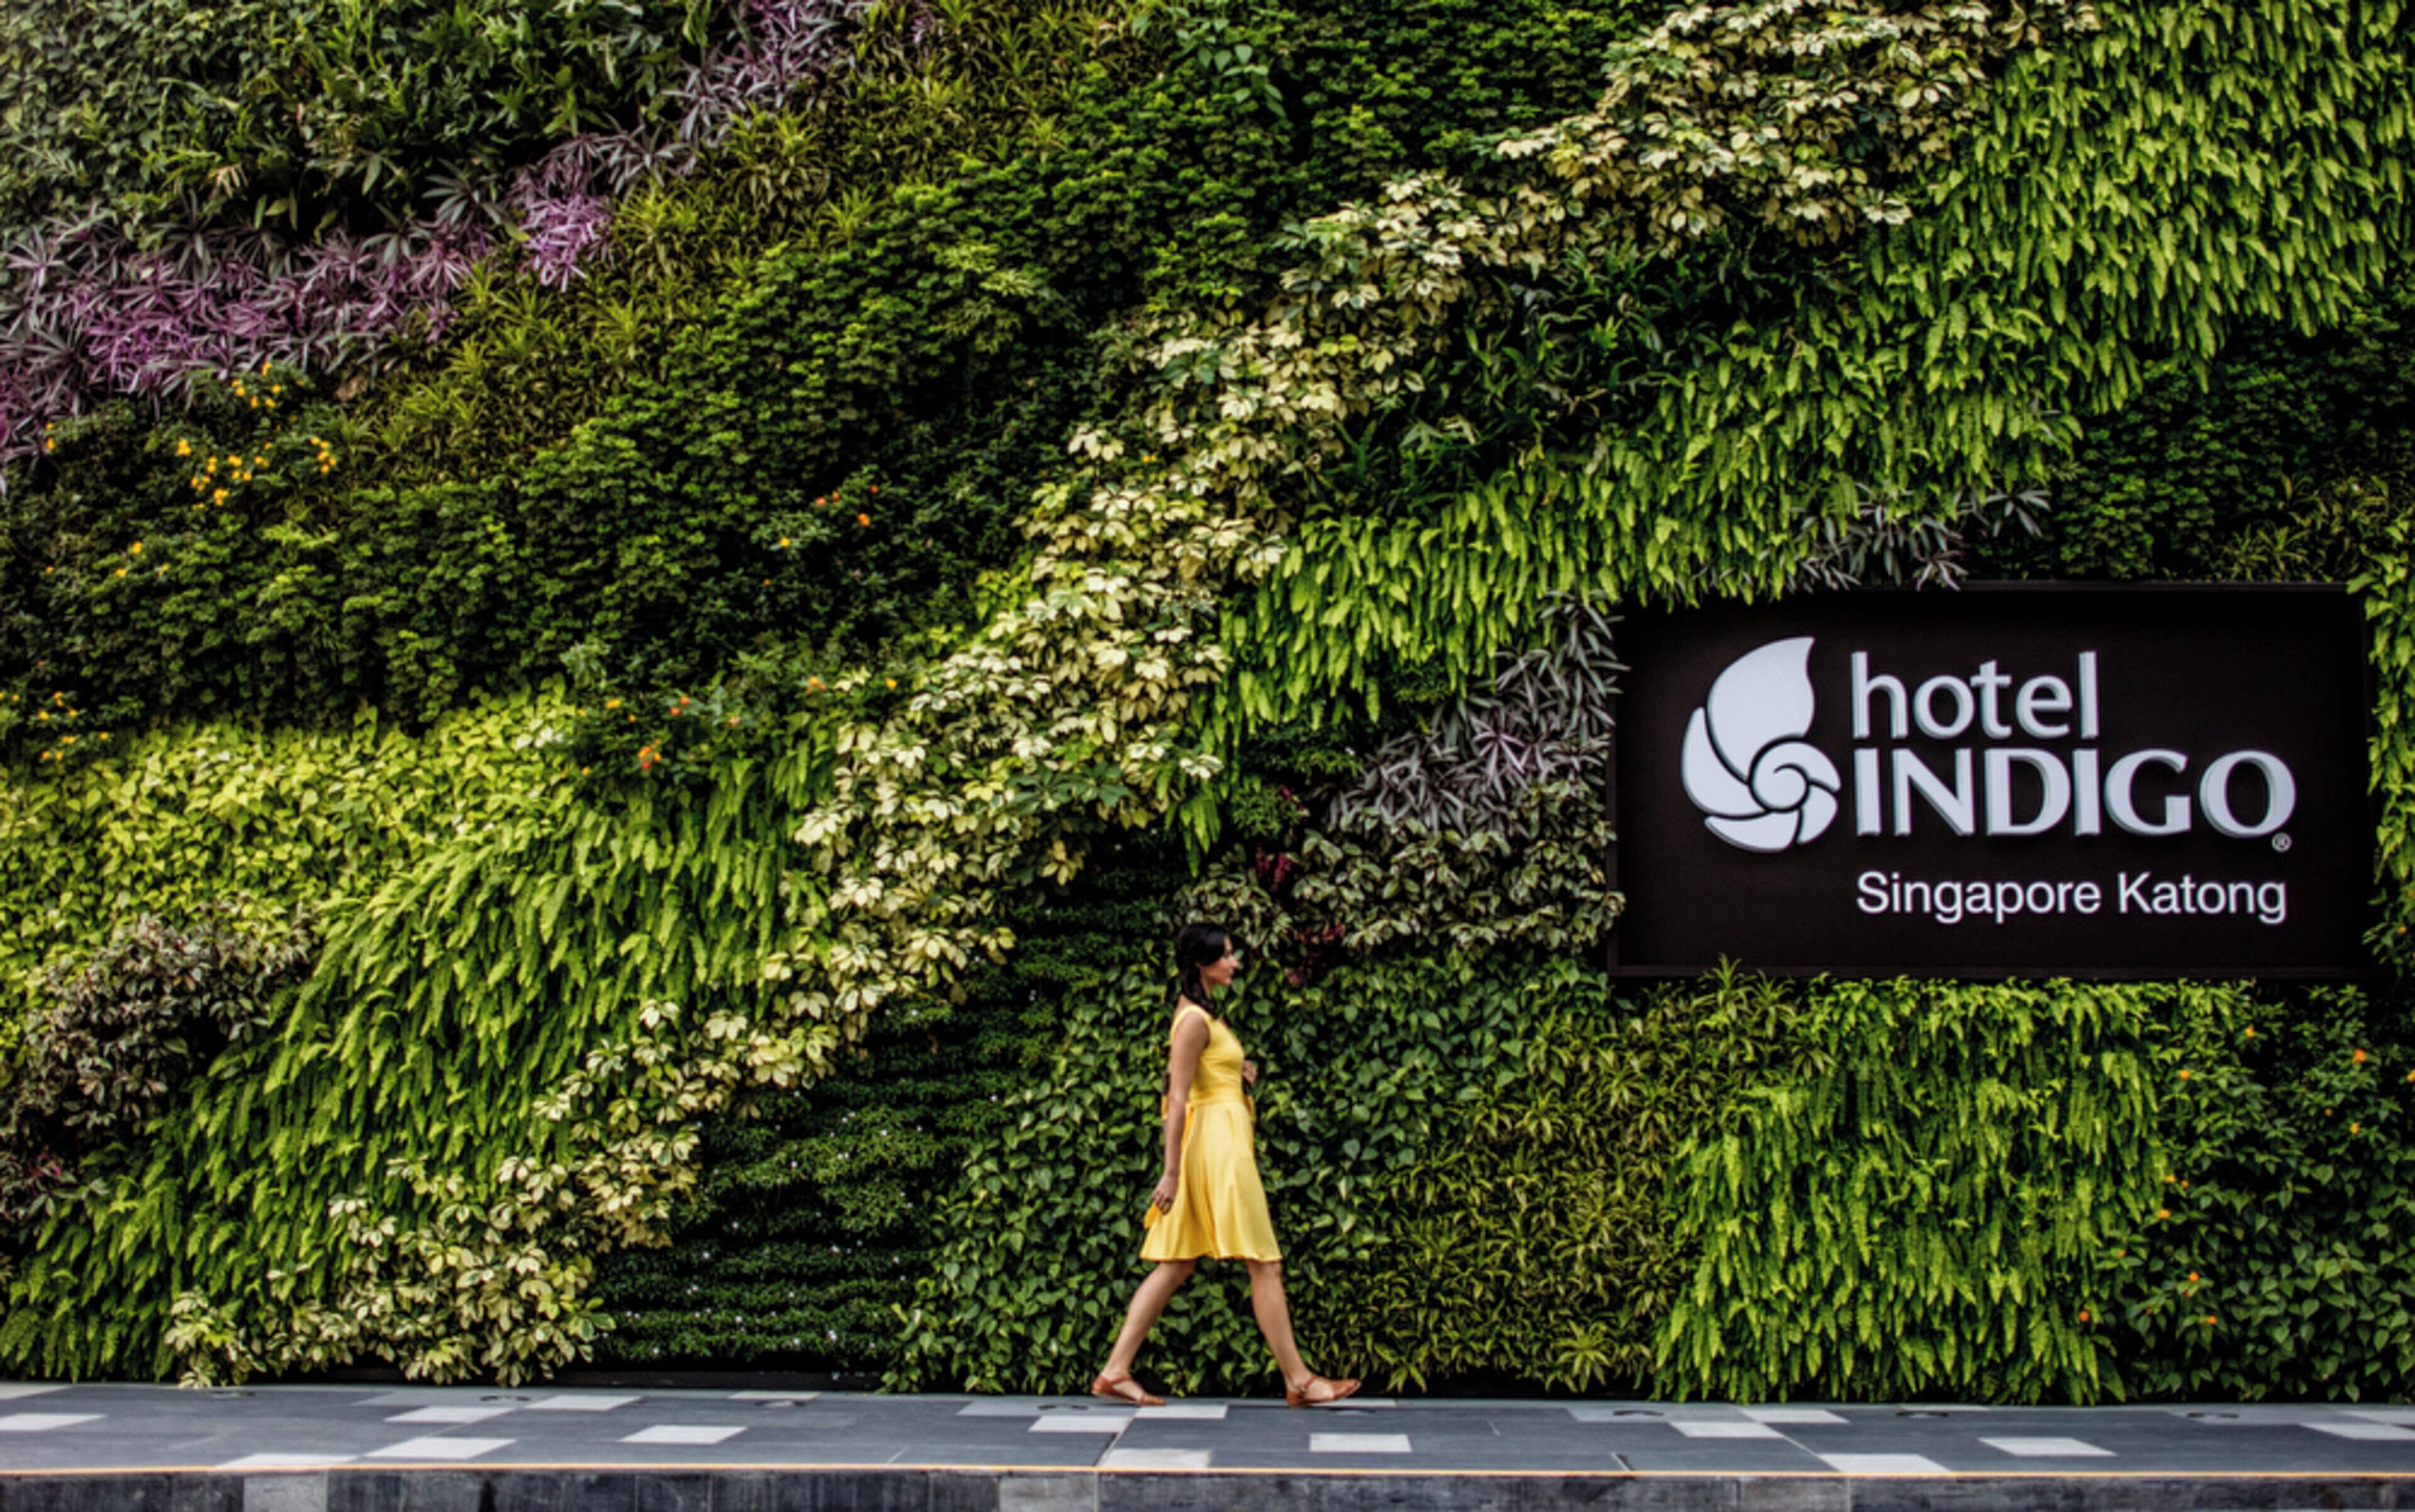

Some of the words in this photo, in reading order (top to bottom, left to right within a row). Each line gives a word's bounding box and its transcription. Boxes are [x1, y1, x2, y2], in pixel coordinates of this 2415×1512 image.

[1851, 651, 2099, 739] hotel
[1857, 870, 2101, 924] Singapore
[2118, 872, 2286, 925] Katong
